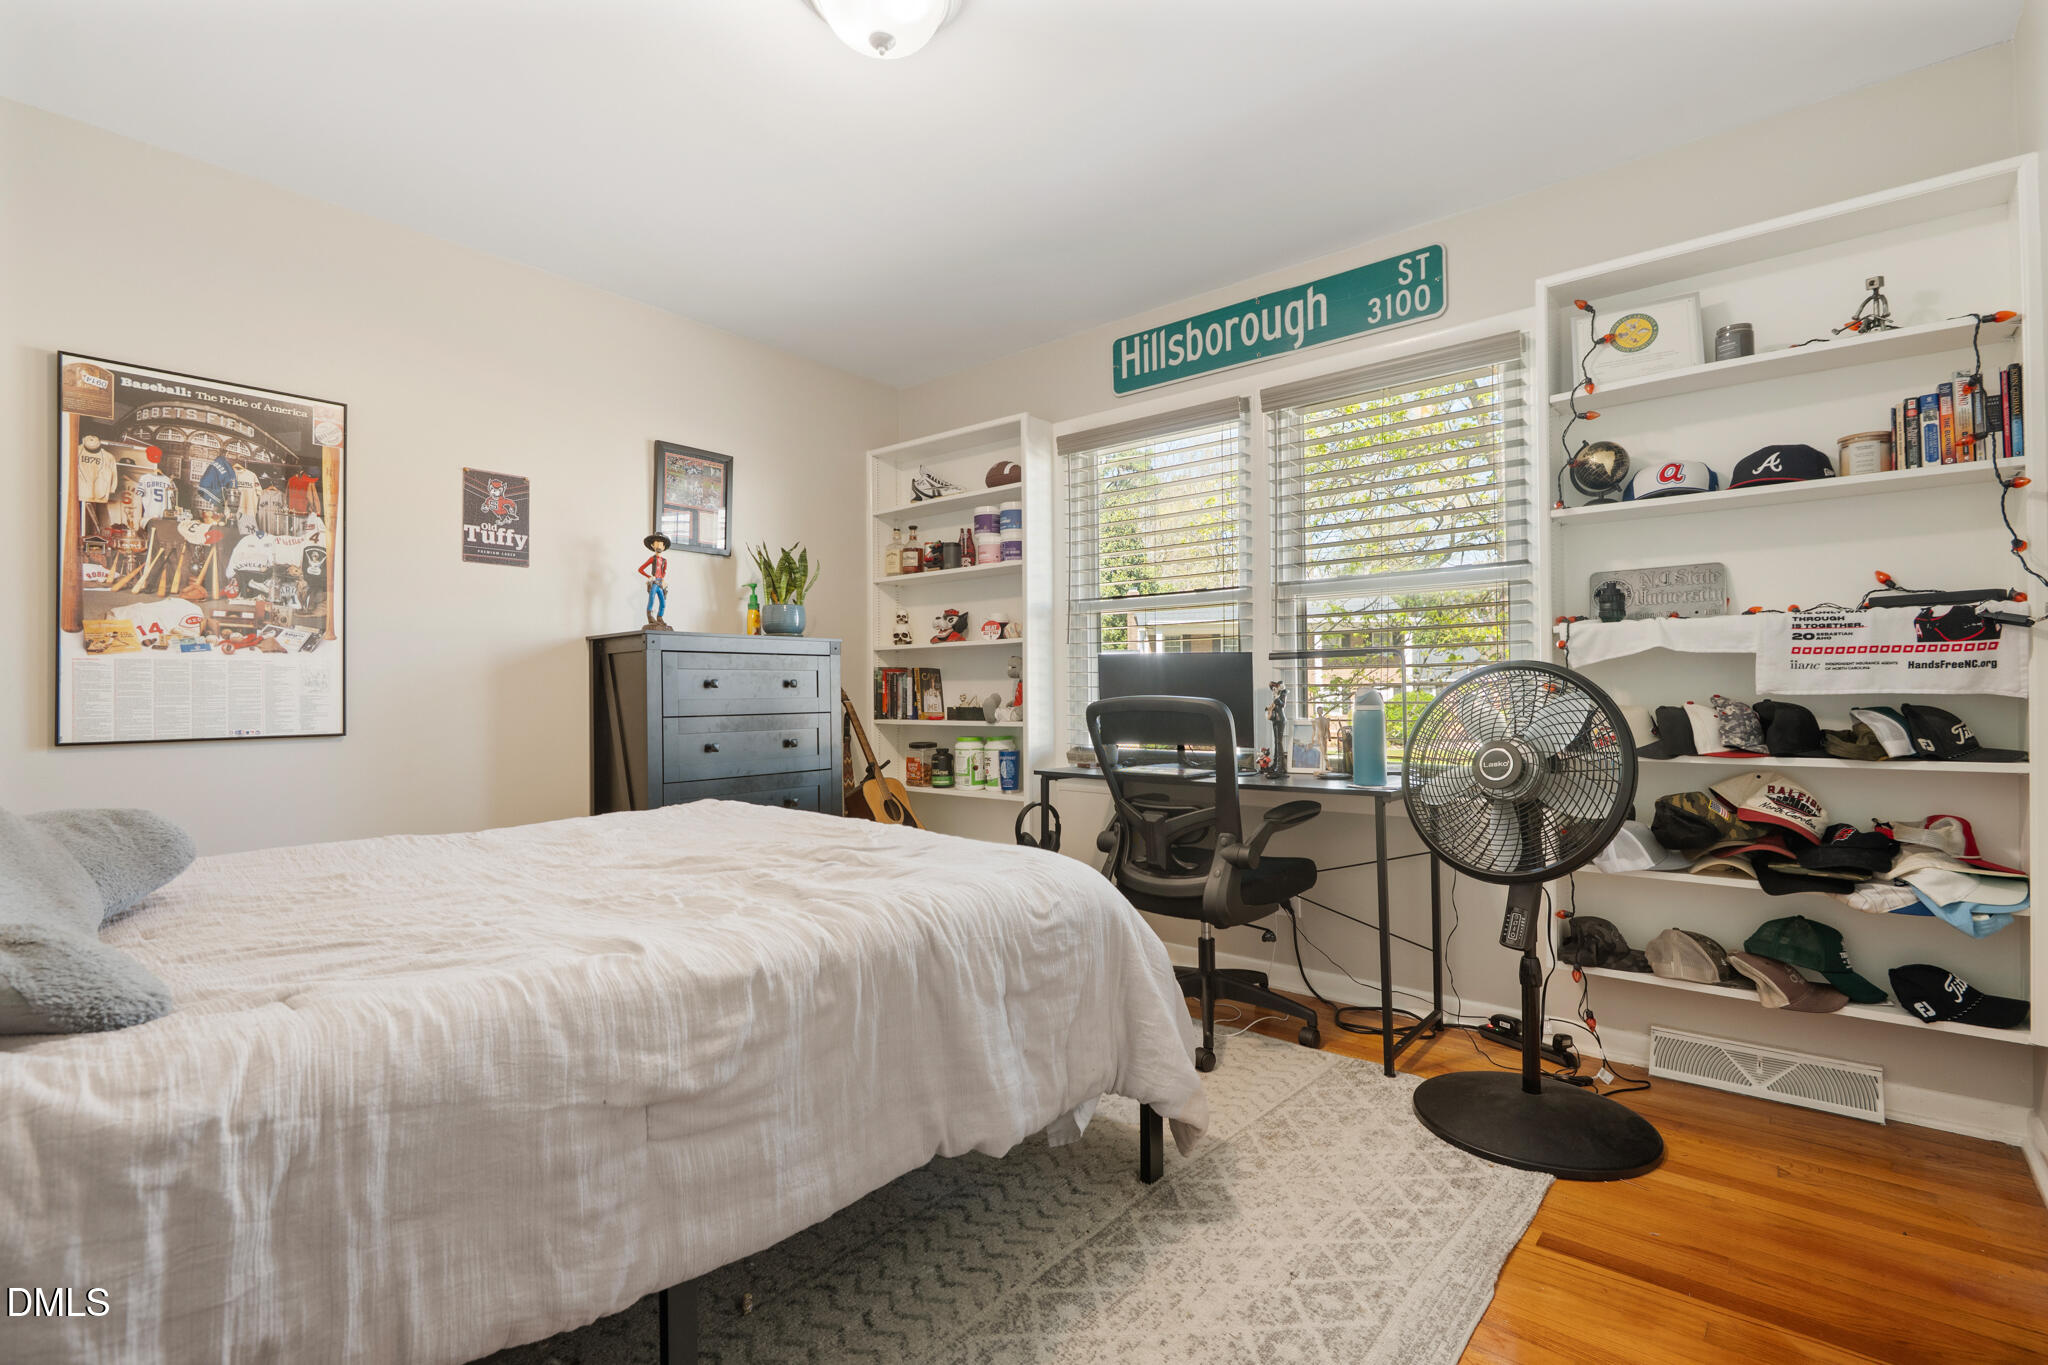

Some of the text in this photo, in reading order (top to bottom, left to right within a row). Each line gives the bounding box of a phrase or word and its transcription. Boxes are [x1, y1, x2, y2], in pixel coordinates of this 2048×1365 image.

[1398, 252, 1430, 286] ST
[1121, 284, 1431, 379] Hillsborough 3100
[120, 376, 191, 398] Baseball:
[196, 391, 218, 402] The
[219, 395, 248, 408] Pride
[251, 401, 263, 410] of
[263, 403, 309, 418] America
[136, 407, 255, 438] EBBETS FIELD
[1943, 416, 1951, 429] THE
[1944, 430, 1953, 456] BURNING
[80, 455, 102, 465] 1876
[1752, 451, 1783, 475] A
[153, 489, 164, 502] 5
[481, 522, 497, 532] Old
[309, 532, 321, 544] 4
[463, 524, 528, 551] Tuffy
[1634, 587, 1725, 606] University
[136, 621, 164, 637] 14
[1792, 632, 1816, 641] 20
[1790, 659, 1821, 670] iianc
[1908, 659, 1997, 669] HandsFreeNC.org
[1483, 760, 1509, 768] Lasko
[1758, 801, 1784, 814] North
[1767, 785, 1822, 814] RALEIGH
